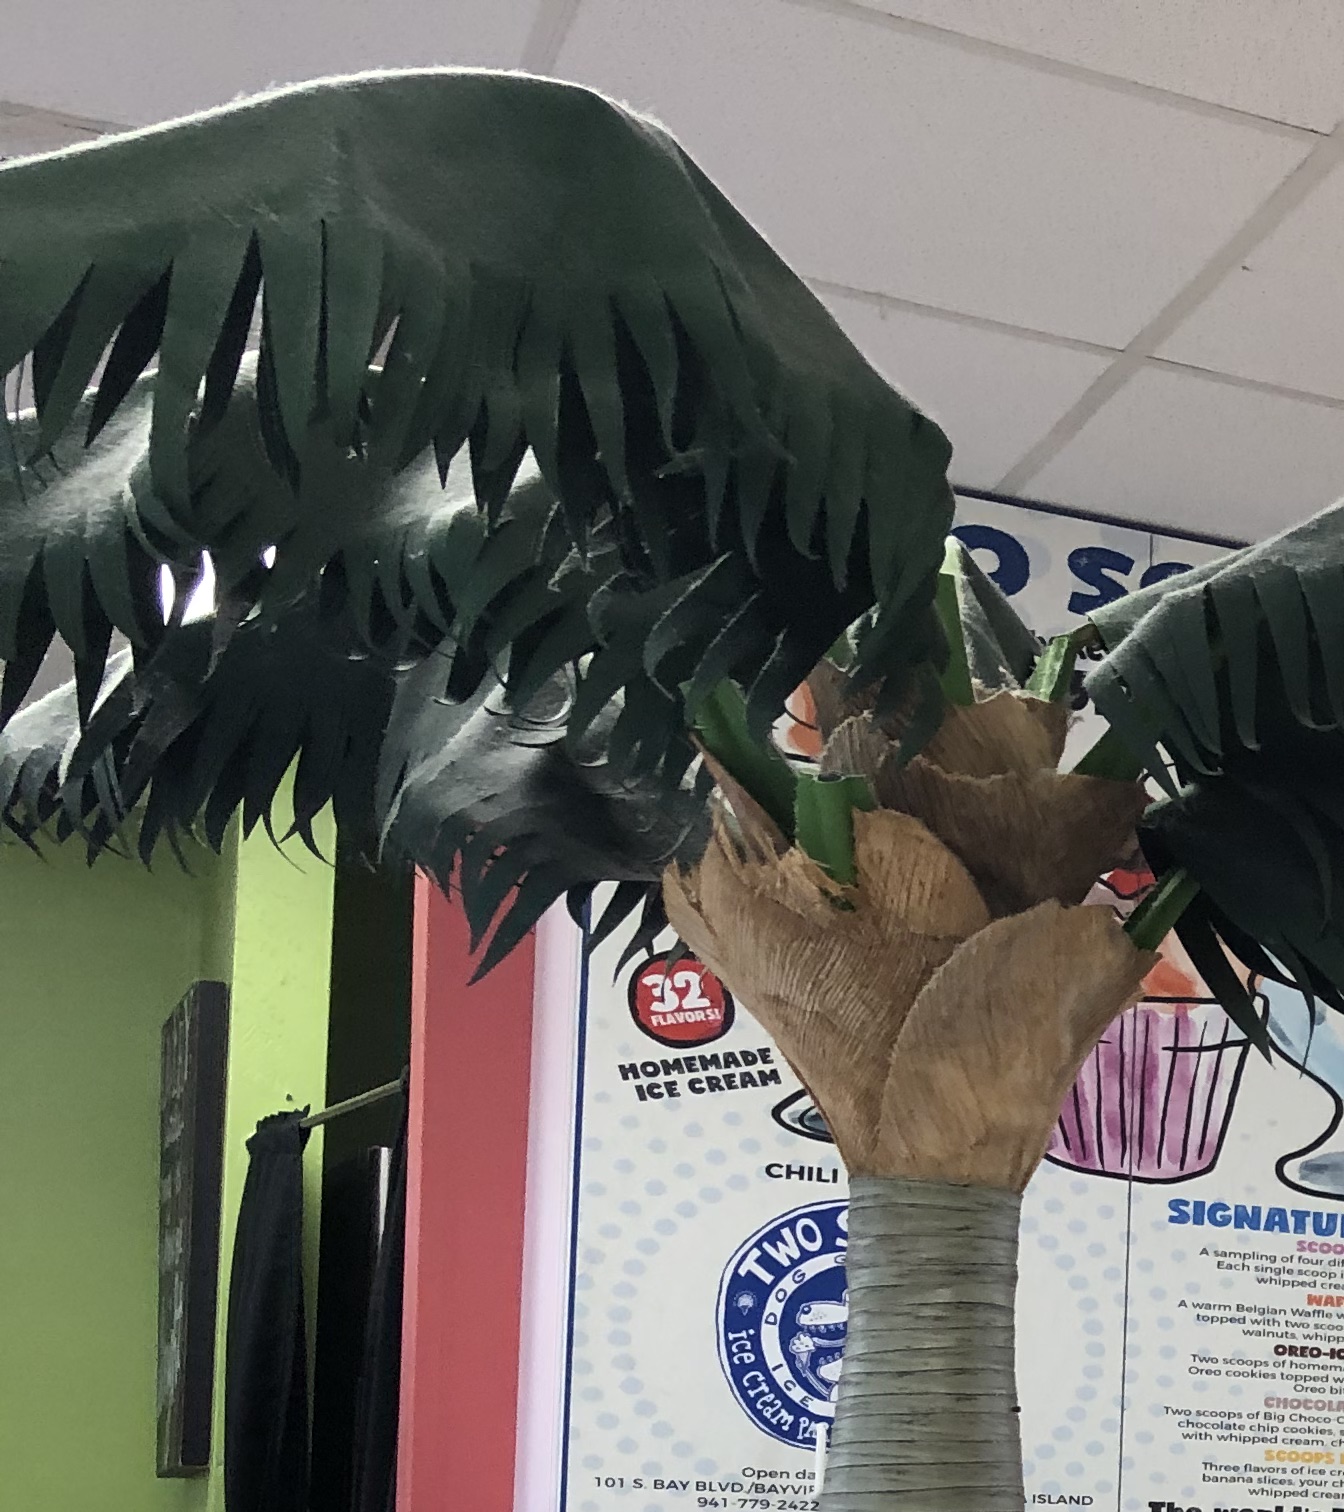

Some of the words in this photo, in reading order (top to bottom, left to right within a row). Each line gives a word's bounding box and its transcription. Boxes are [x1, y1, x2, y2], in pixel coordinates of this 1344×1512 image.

[641, 970, 710, 1013] 32
[650, 1009, 721, 1028] FLAVORS!
[618, 1048, 774, 1081] HOMEMADE
[635, 1080, 682, 1101] ICE
[688, 1069, 781, 1095] CREAM
[765, 1162, 839, 1183] CHILI
[738, 1217, 822, 1285] TWO
[1199, 1248, 1209, 1256] A
[1213, 1250, 1277, 1264] sampling
[1281, 1254, 1294, 1264] of
[1297, 1255, 1324, 1267] four
[765, 1269, 806, 1325] DOG
[771, 1363, 813, 1408] ICE
[1264, 1449, 1335, 1464] SCOOPS
[741, 1466, 790, 1482] Open
[594, 1477, 626, 1489] 101
[632, 1478, 649, 1491] S.
[653, 1479, 690, 1492] BAY
[696, 1496, 819, 1512] 941-779-2422
[1032, 1493, 1094, 1507] ISLAND
